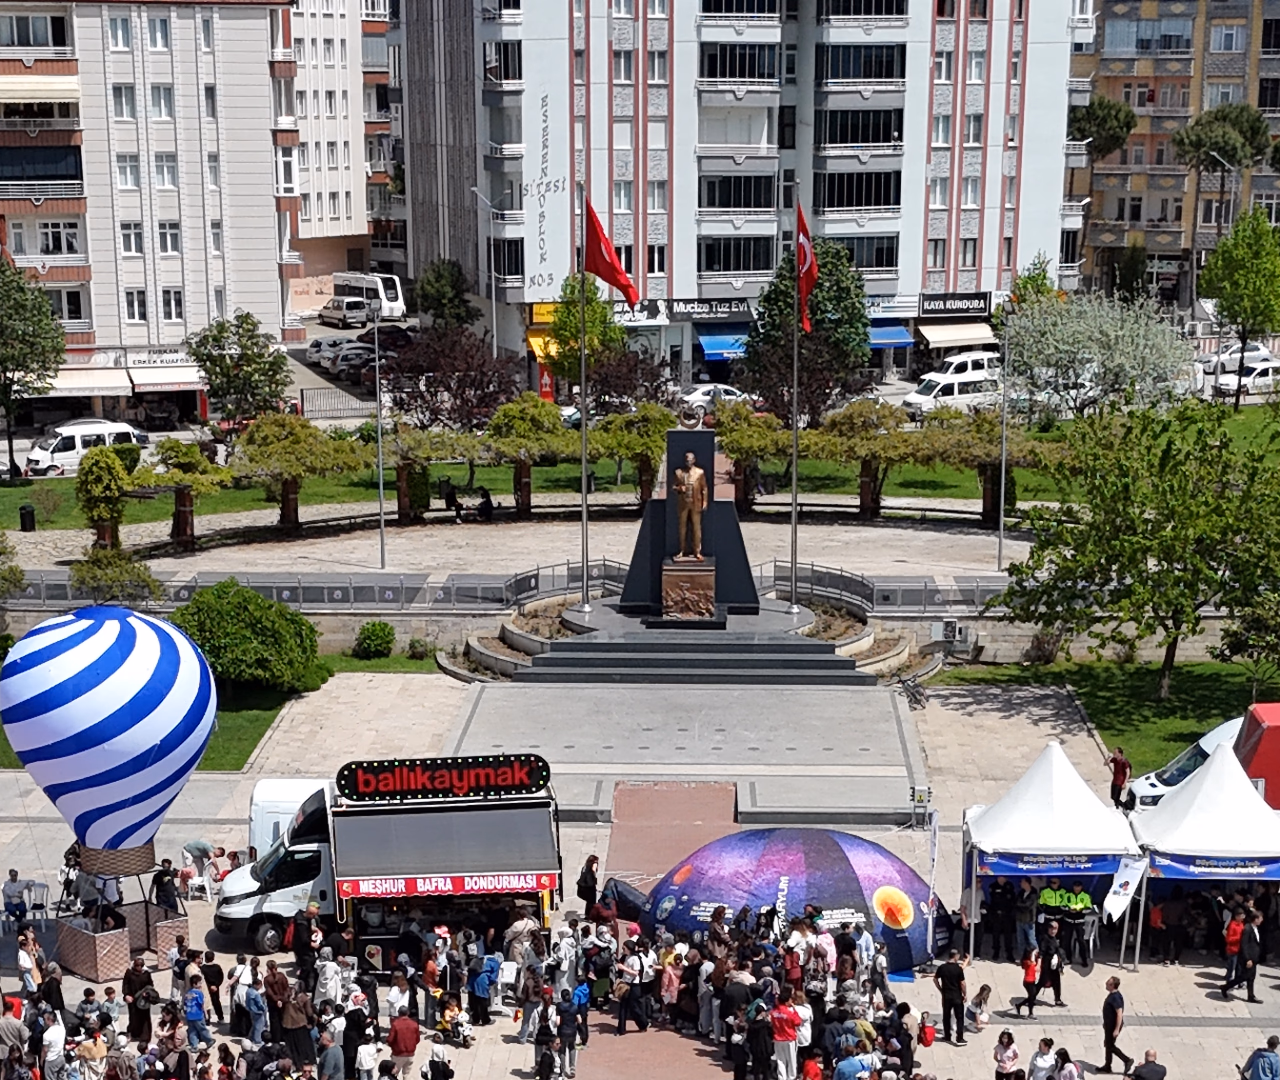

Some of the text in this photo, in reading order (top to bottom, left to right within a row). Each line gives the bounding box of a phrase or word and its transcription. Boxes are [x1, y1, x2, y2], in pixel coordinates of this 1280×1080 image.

[673, 301, 748, 312] Mucize Tuz Evi
[923, 299, 985, 309] KAYA KUNDURA
[357, 761, 531, 794] ballıkaymak
[359, 874, 537, 894] MEŞHUR BAFRA DONDURMASI
